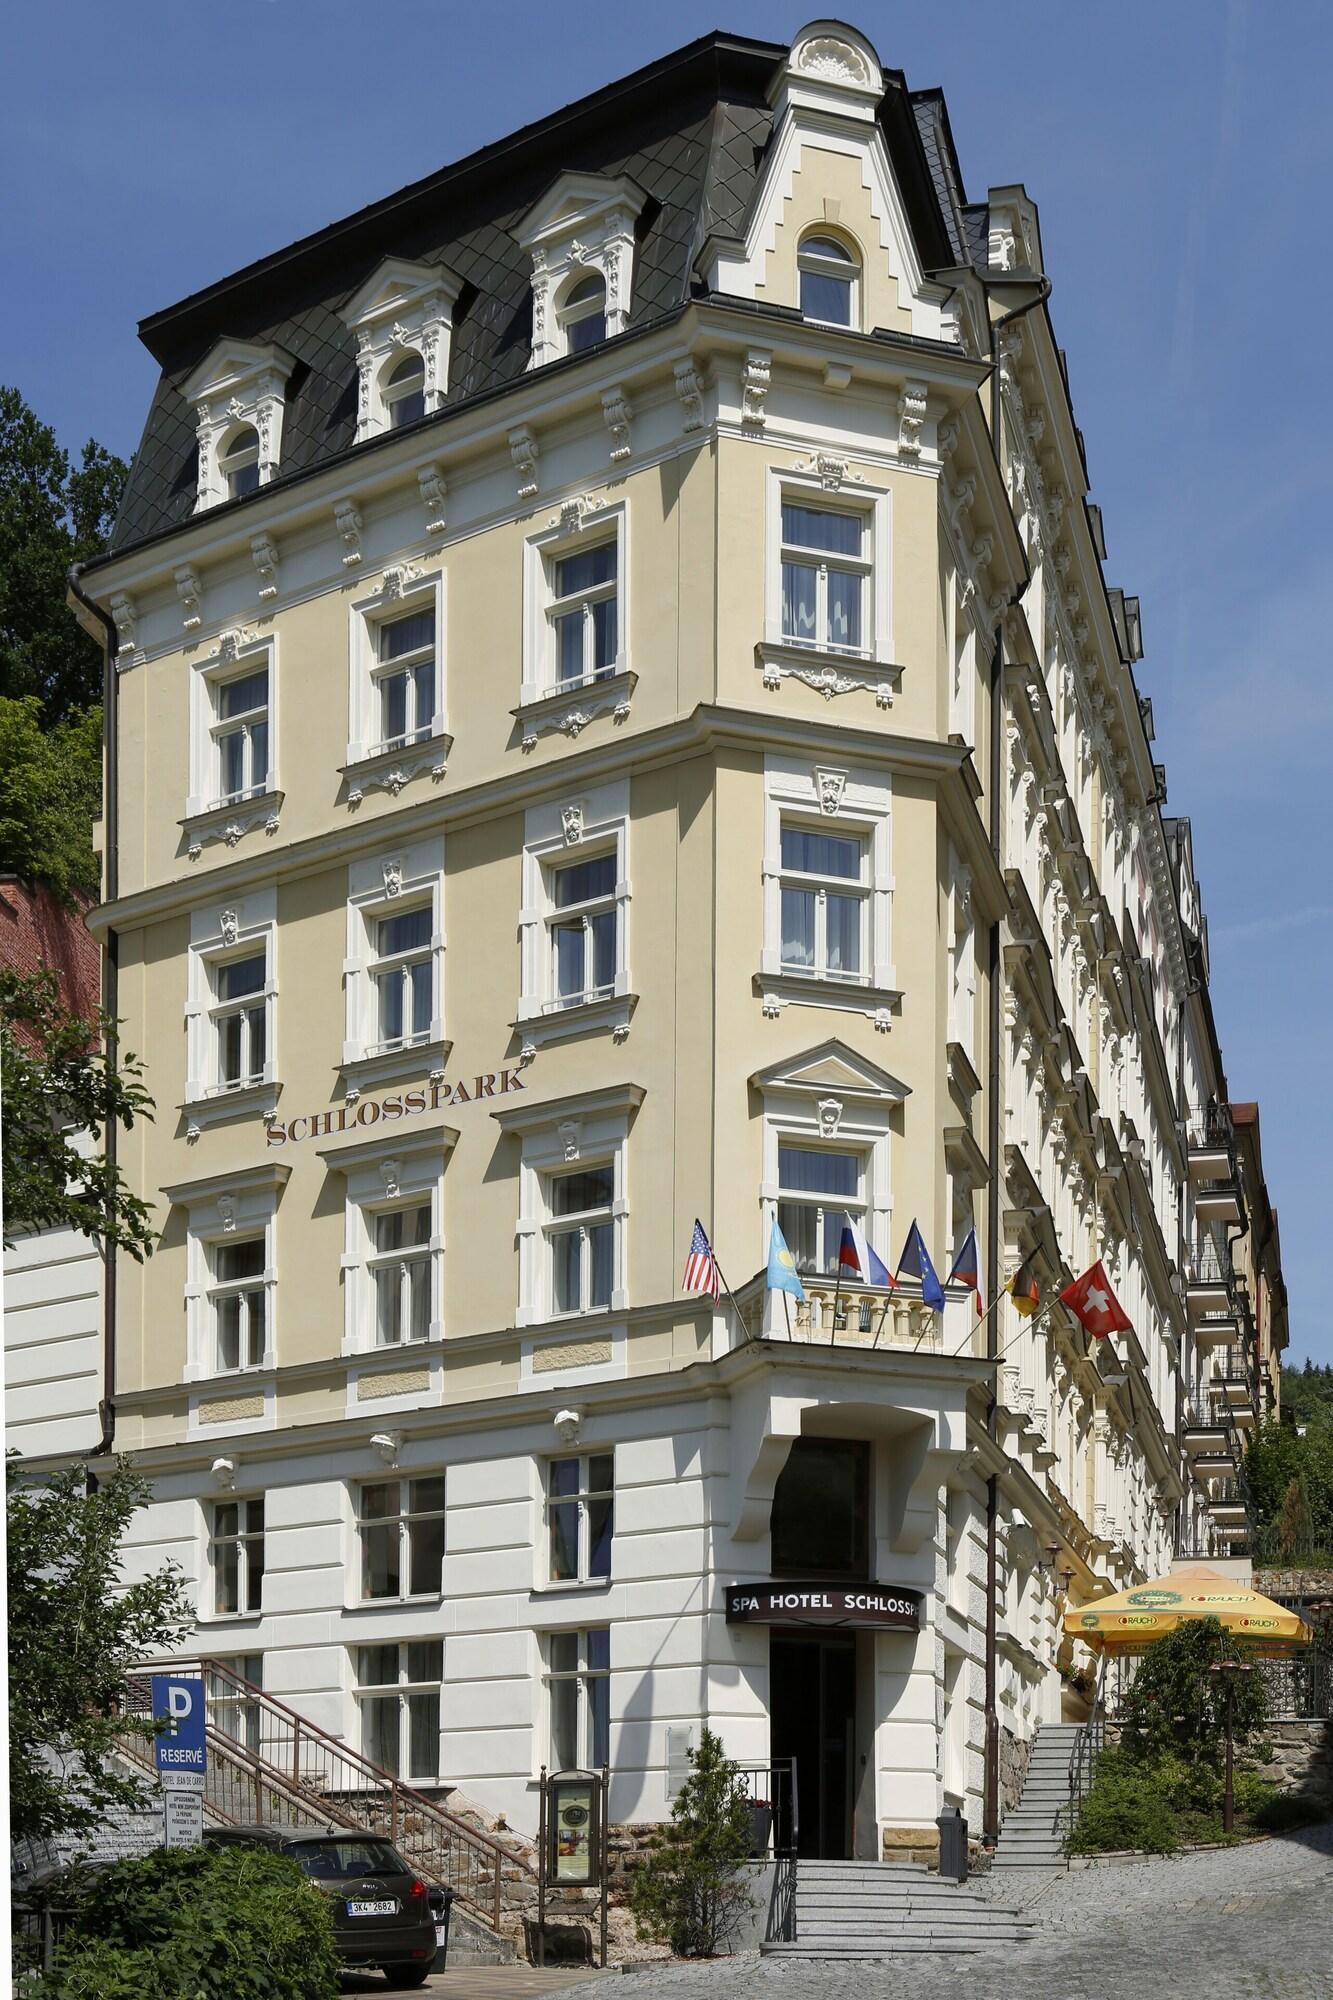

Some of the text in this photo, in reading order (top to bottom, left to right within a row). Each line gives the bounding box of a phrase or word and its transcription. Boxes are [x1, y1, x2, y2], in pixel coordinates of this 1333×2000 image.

[266, 1066, 528, 1147] SCHLOSSPARK
[732, 1597, 760, 1612] SPA
[770, 1594, 833, 1609] HOTEL
[1128, 1617, 1153, 1625] RAUCH
[1249, 1619, 1275, 1628] RAUCH
[168, 1686, 192, 1736] P
[160, 1746, 203, 1764] RESERVÉ
[353, 1902, 392, 1912] 3K4 2682
